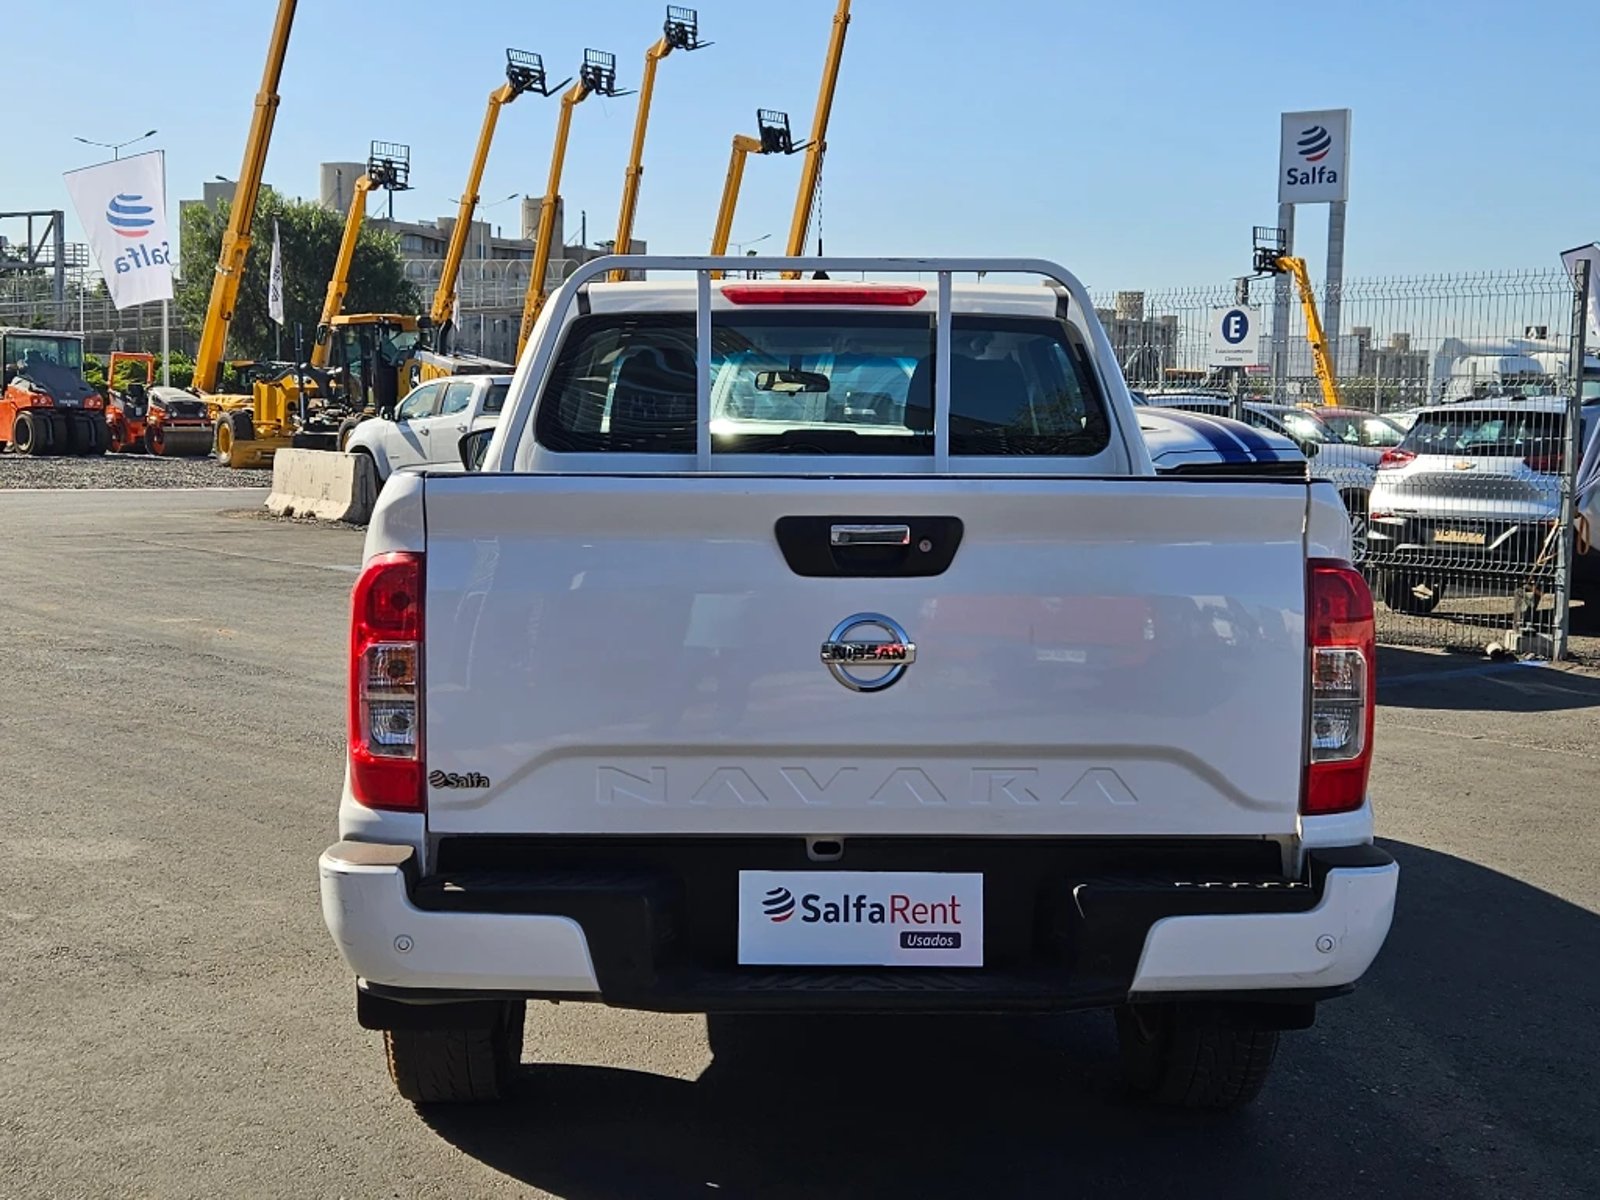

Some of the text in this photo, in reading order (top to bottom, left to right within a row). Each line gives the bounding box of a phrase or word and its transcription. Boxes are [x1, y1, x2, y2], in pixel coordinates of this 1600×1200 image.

[1286, 165, 1337, 186] Salfa
[1229, 316, 1242, 339] E
[831, 646, 906, 660] NISSAN
[447, 771, 490, 789] Salfa
[596, 766, 1139, 805] NAVARA
[801, 893, 962, 925] SalfaRent
[906, 933, 954, 947] Usados
